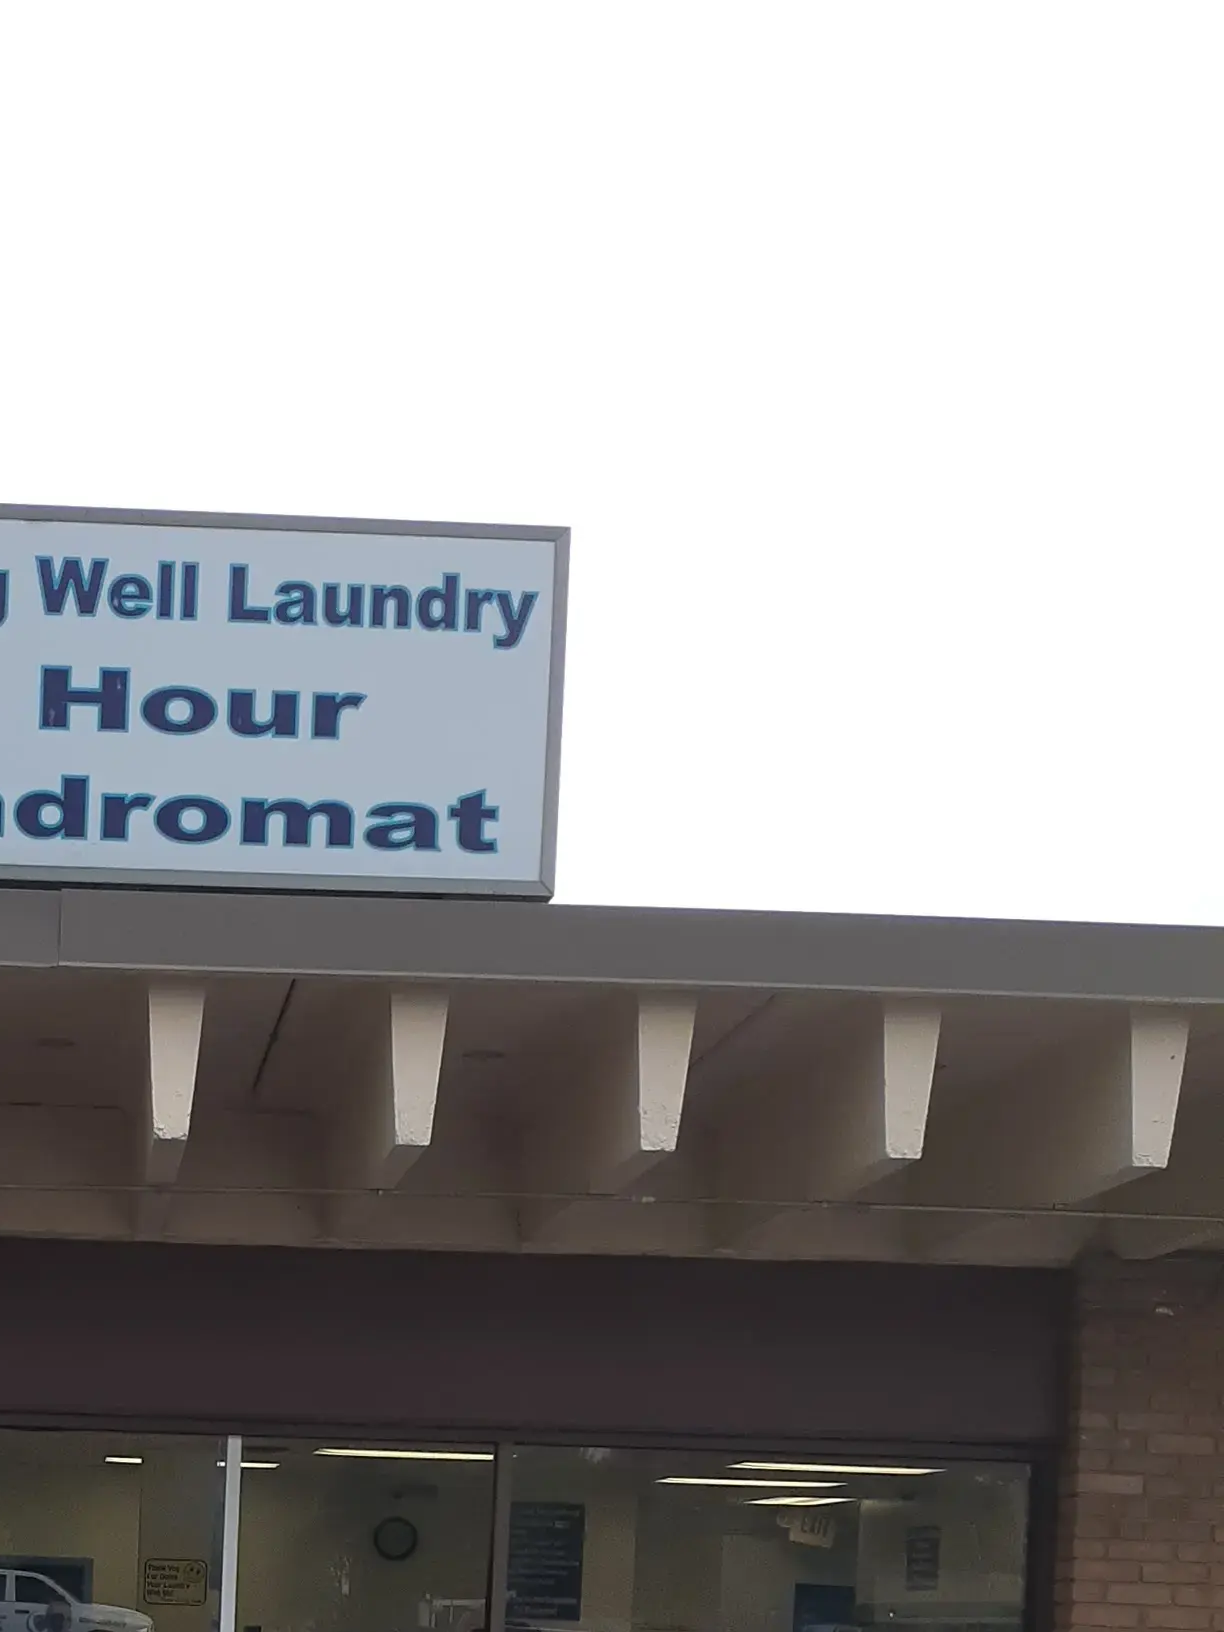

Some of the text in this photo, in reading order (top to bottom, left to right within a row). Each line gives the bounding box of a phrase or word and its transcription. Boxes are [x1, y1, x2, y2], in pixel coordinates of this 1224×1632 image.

[34, 555, 200, 621] Well
[227, 562, 540, 651] Laundry
[37, 664, 368, 741] Hour
[800, 1512, 832, 1539] EXIT
